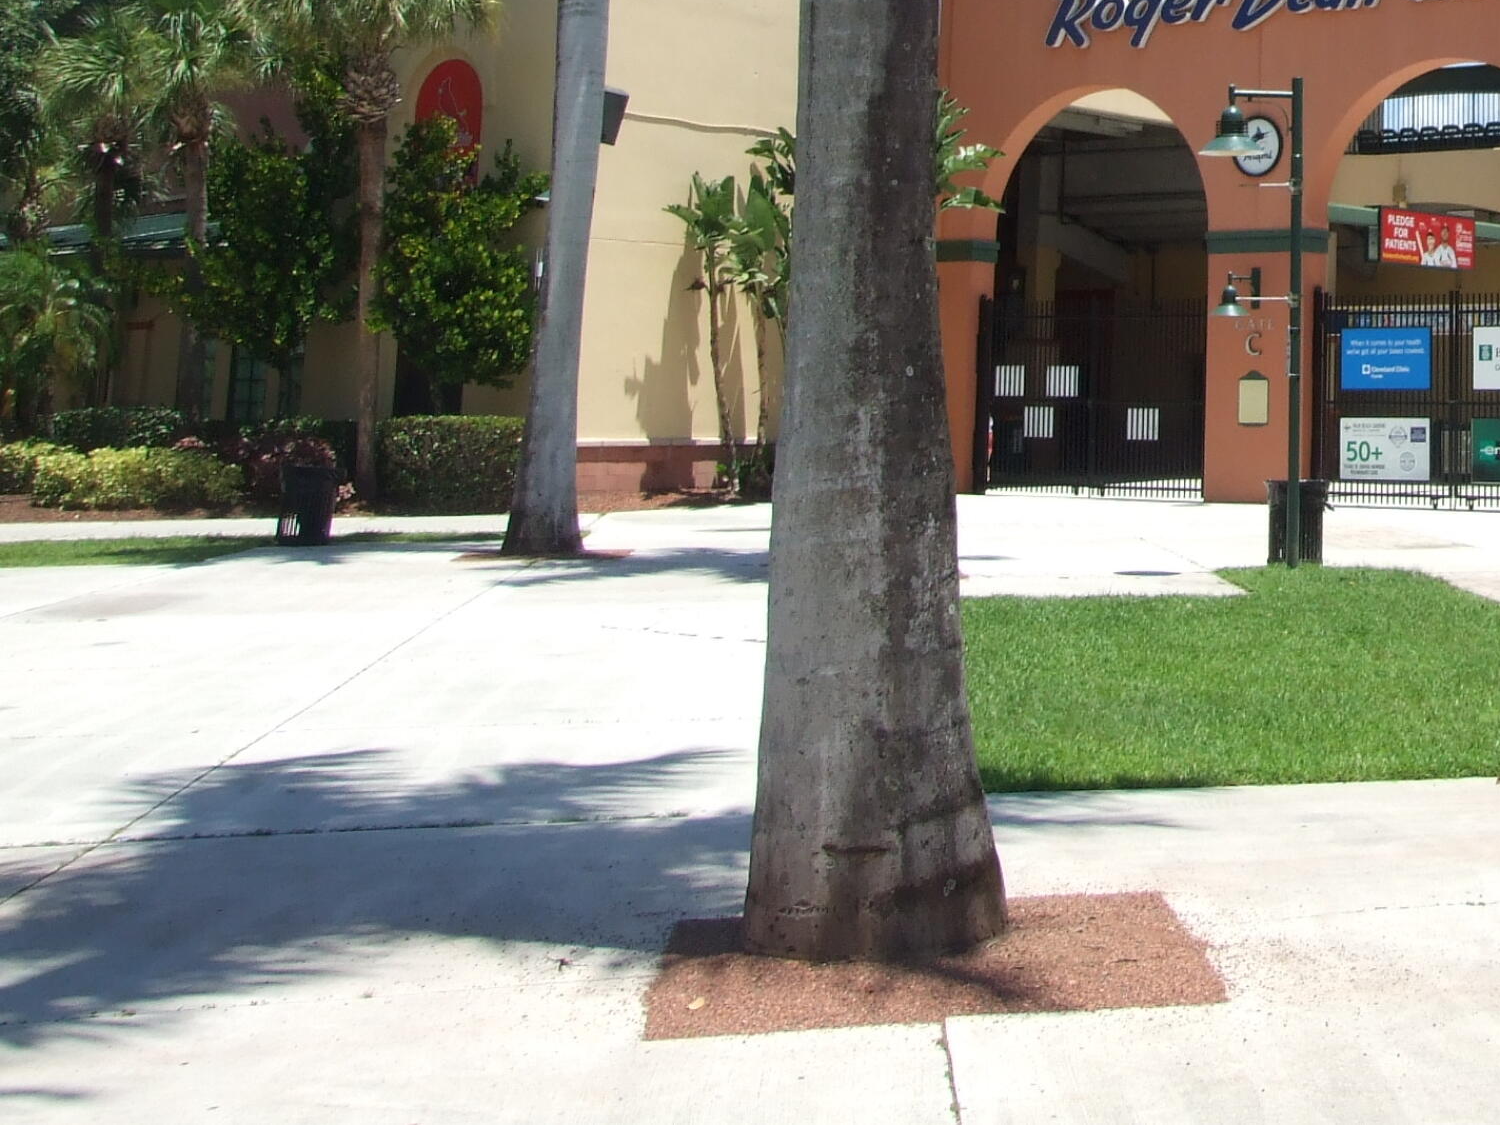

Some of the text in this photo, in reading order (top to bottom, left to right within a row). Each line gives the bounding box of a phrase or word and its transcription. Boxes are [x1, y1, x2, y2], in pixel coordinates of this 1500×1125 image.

[1387, 214, 1416, 228] PLEDGE
[1393, 226, 1409, 239] FOR
[1384, 238, 1418, 252] PATIENTS
[1244, 331, 1263, 356] C
[1346, 440, 1383, 462] 50+
